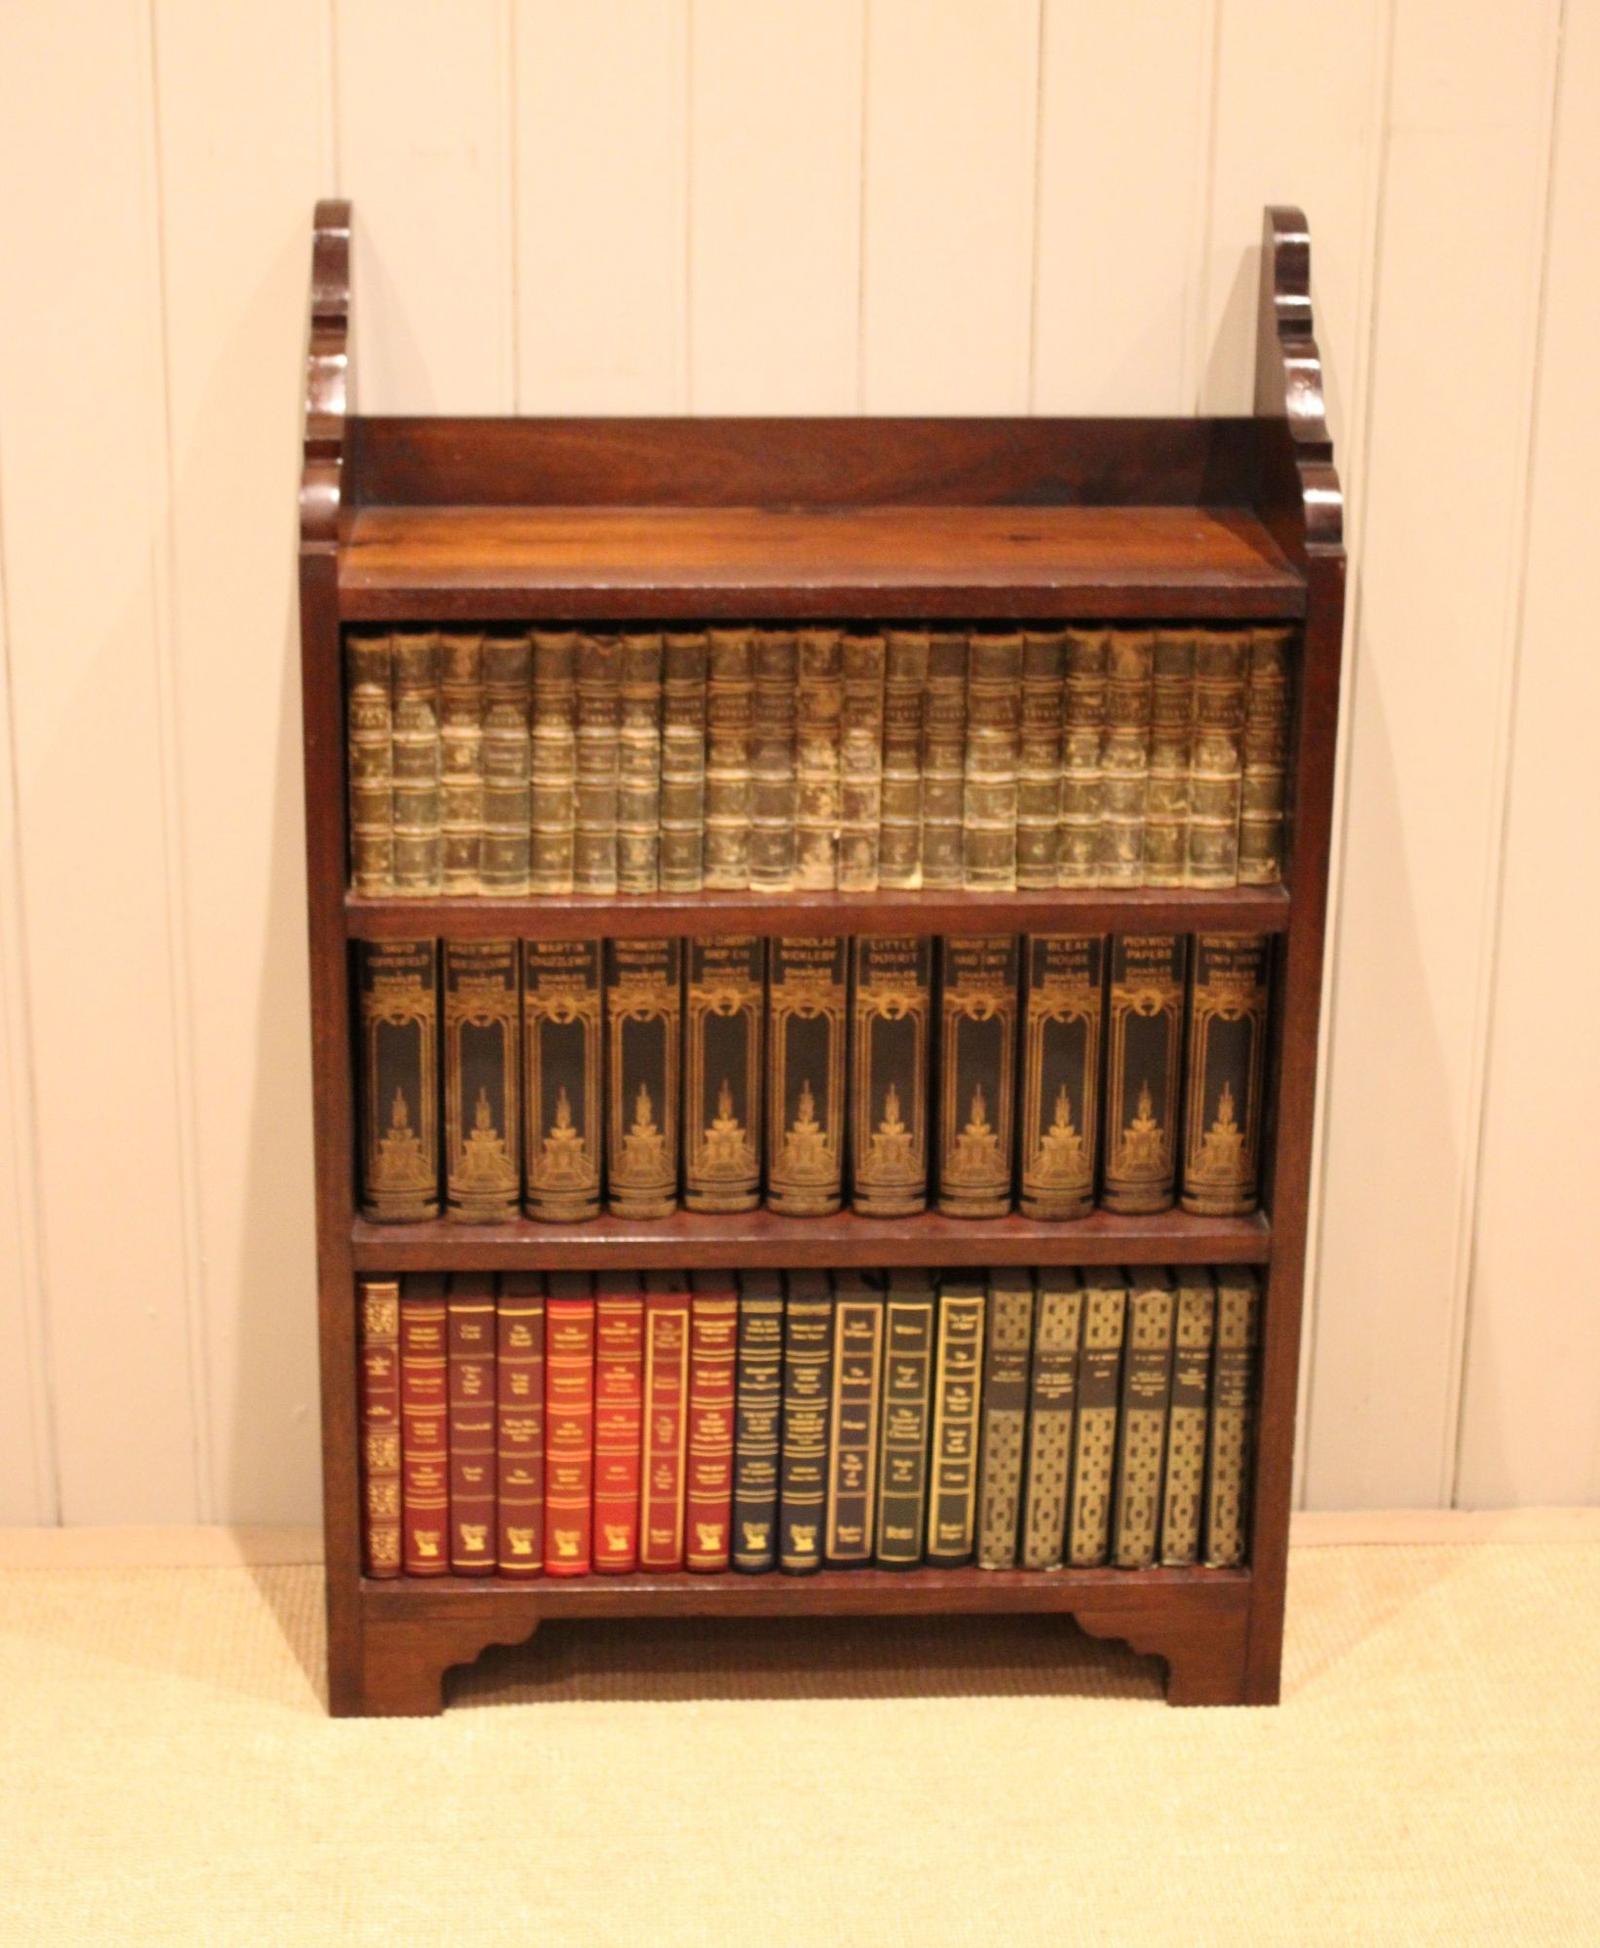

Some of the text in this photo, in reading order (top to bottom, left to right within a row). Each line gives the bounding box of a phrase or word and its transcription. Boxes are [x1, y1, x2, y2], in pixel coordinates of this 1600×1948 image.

[870, 940, 918, 951] LITTLE
[1123, 936, 1175, 947] PICKWICK
[780, 950, 836, 961] NICKLEBY
[869, 953, 918, 963] DORRIT
[1125, 949, 1172, 959] PAPERS
